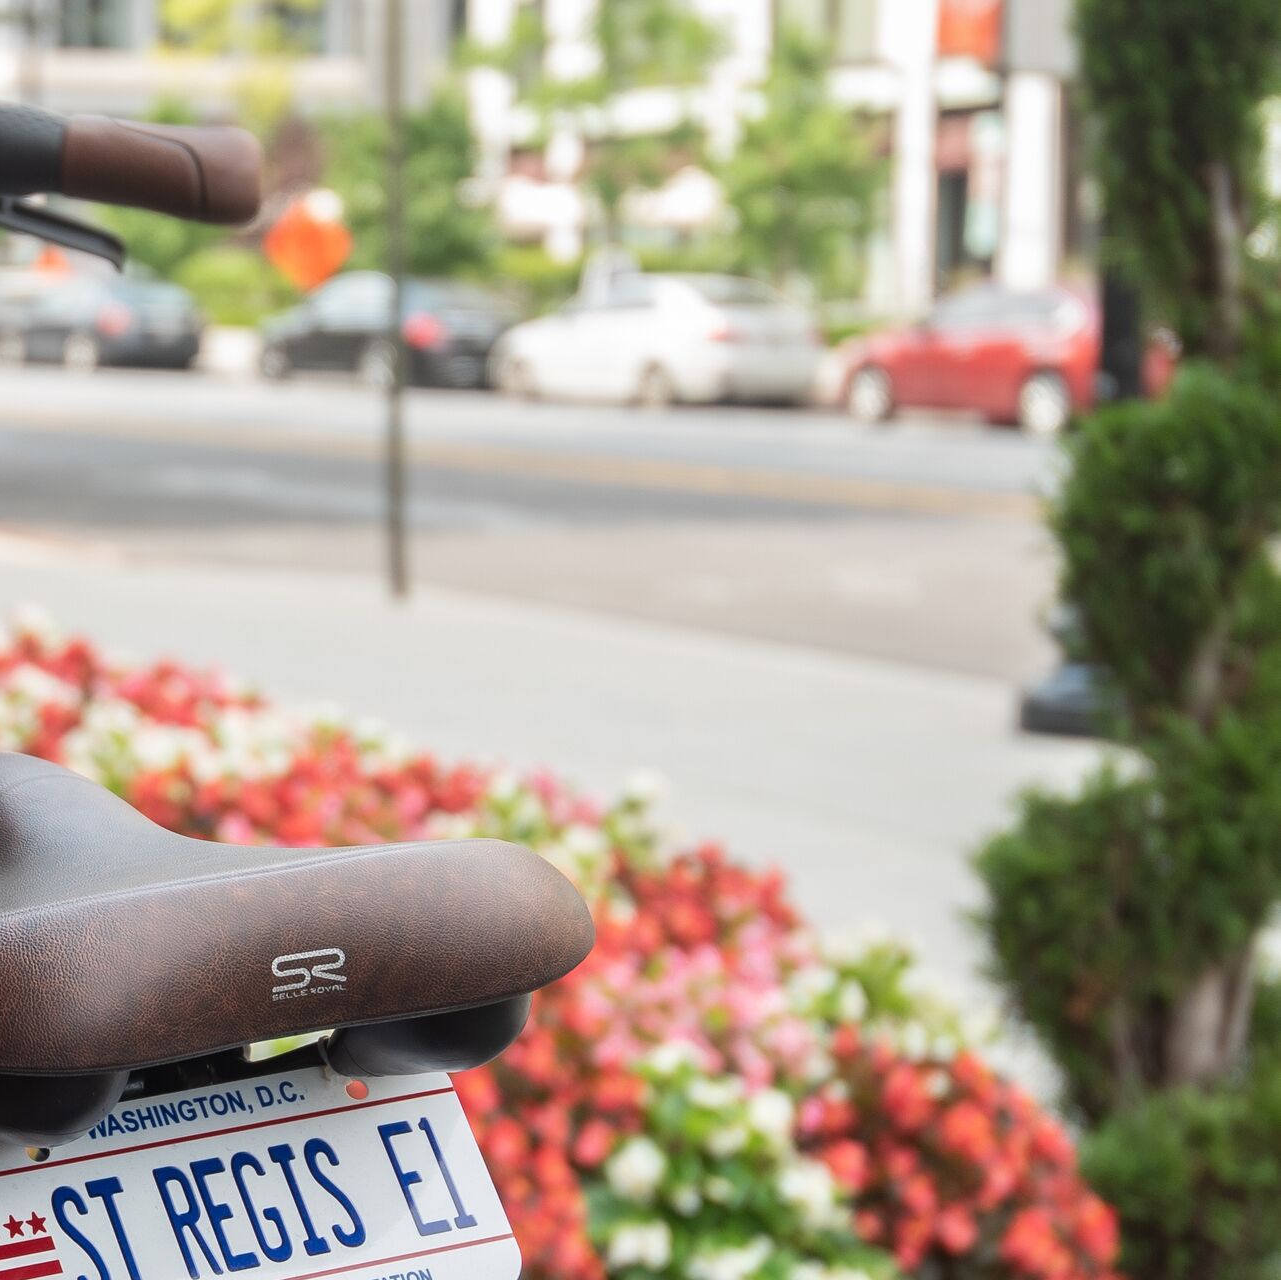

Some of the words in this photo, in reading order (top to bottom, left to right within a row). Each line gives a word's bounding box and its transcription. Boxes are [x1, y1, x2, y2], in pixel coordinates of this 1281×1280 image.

[272, 989, 308, 1002] SELLE
[310, 983, 347, 995] ROYAL
[254, 1080, 306, 1108] D.C.
[152, 1137, 367, 1280] REGIS
[377, 1117, 479, 1238] E1
